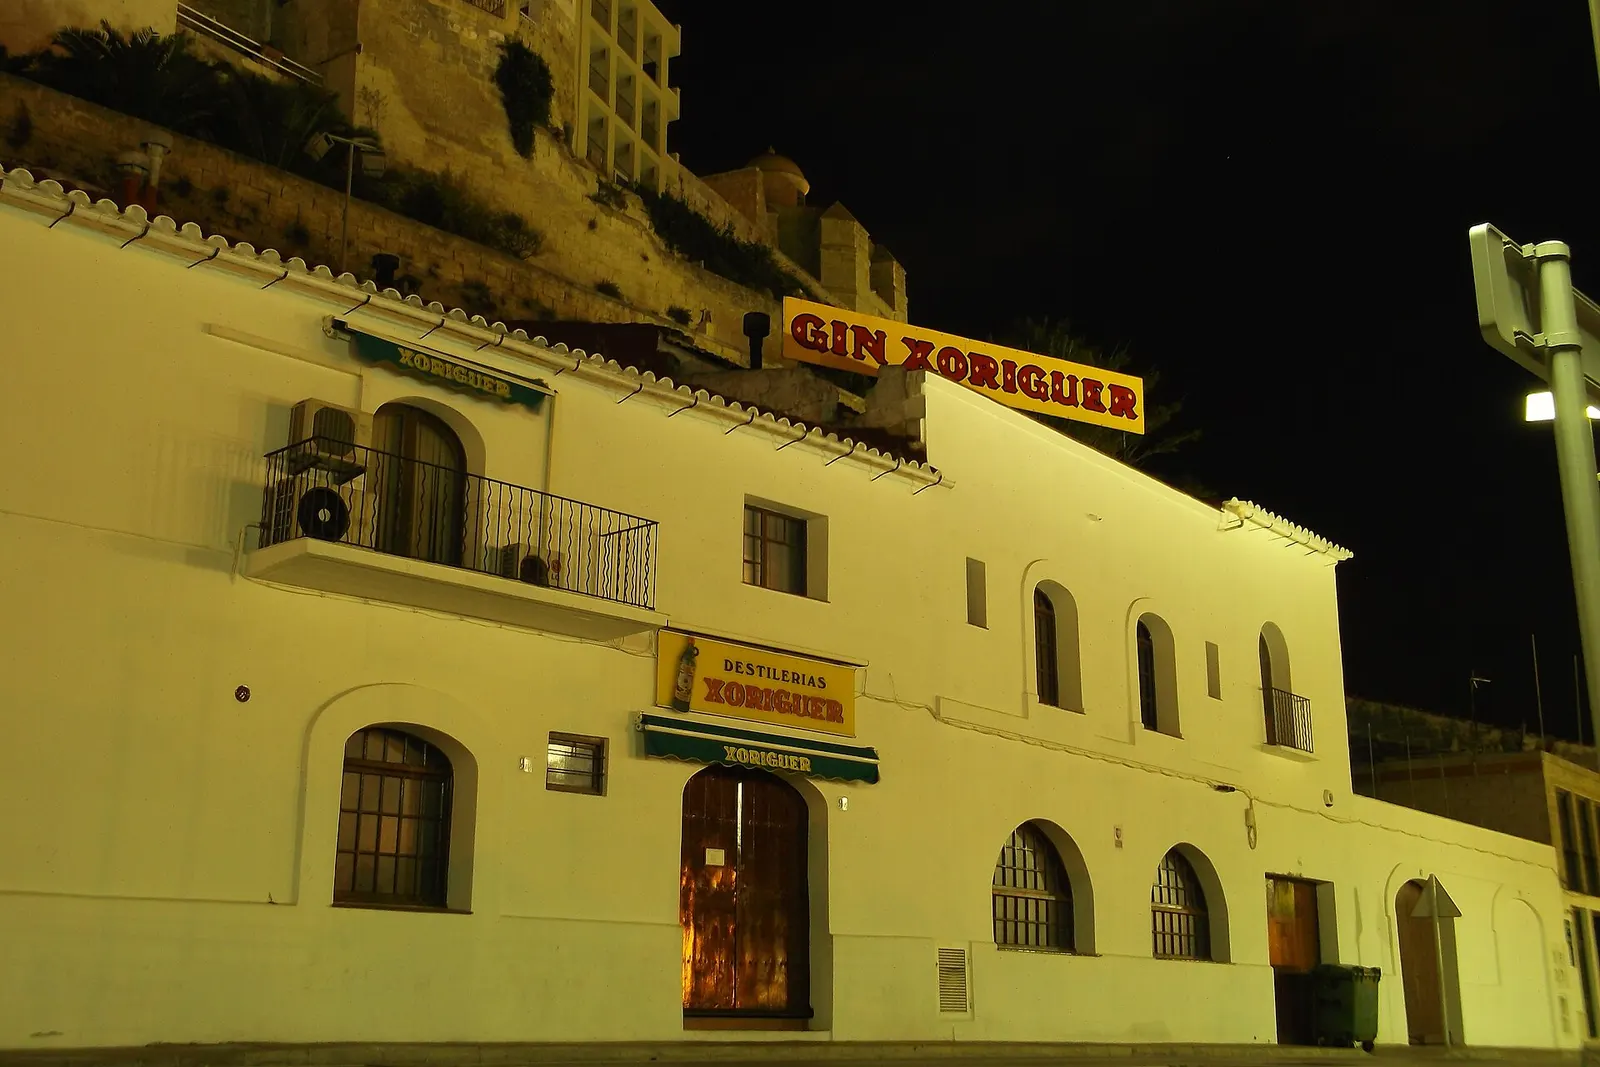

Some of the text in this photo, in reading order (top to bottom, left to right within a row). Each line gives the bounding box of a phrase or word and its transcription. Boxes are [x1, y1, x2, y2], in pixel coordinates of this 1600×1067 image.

[398, 348, 510, 397] XORIGUER
[791, 313, 1139, 420] GIN XORIGUER
[724, 659, 826, 689] DESTILERIAS
[704, 677, 844, 723] XORIGUER
[724, 746, 811, 771] XORIGUER
